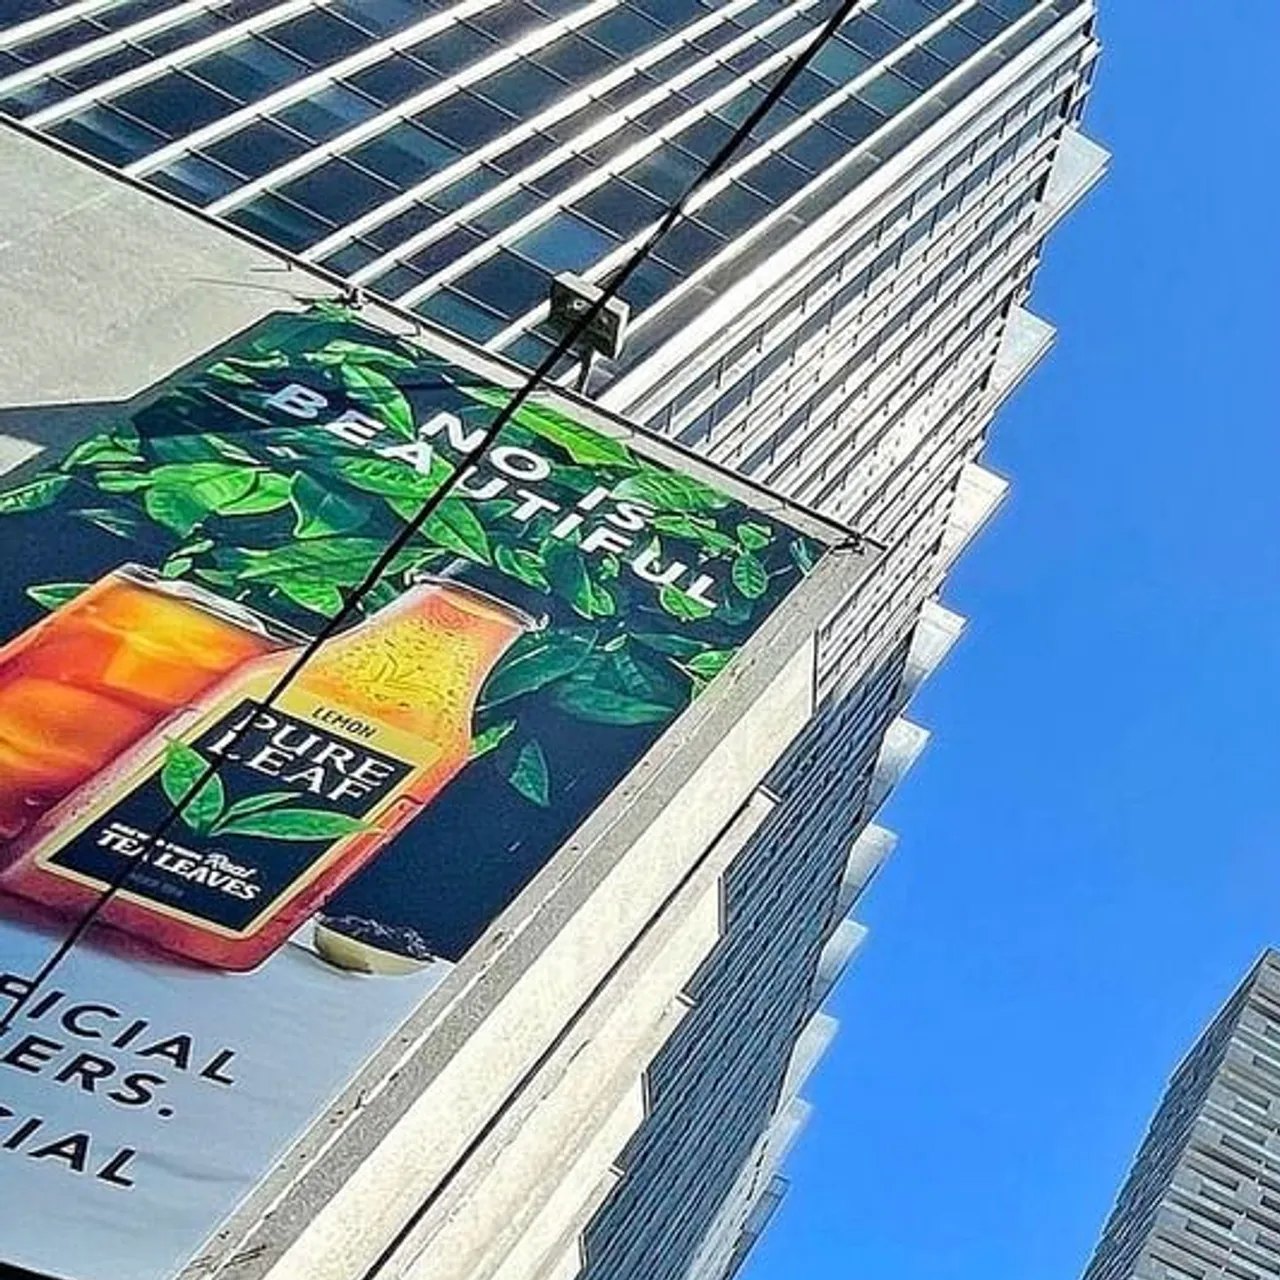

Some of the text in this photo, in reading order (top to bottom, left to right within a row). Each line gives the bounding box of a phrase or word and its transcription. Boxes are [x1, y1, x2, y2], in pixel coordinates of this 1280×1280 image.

[264, 383, 718, 609] BEAUTIFUL
[420, 411, 655, 531] NO IS
[233, 709, 395, 787] PURE
[311, 707, 378, 738] LEMON
[206, 730, 372, 801] LEAF
[154, 852, 262, 900] LEAVES
[0, 1026, 174, 1118] ERS.
[0, 1104, 136, 1187] IAL
